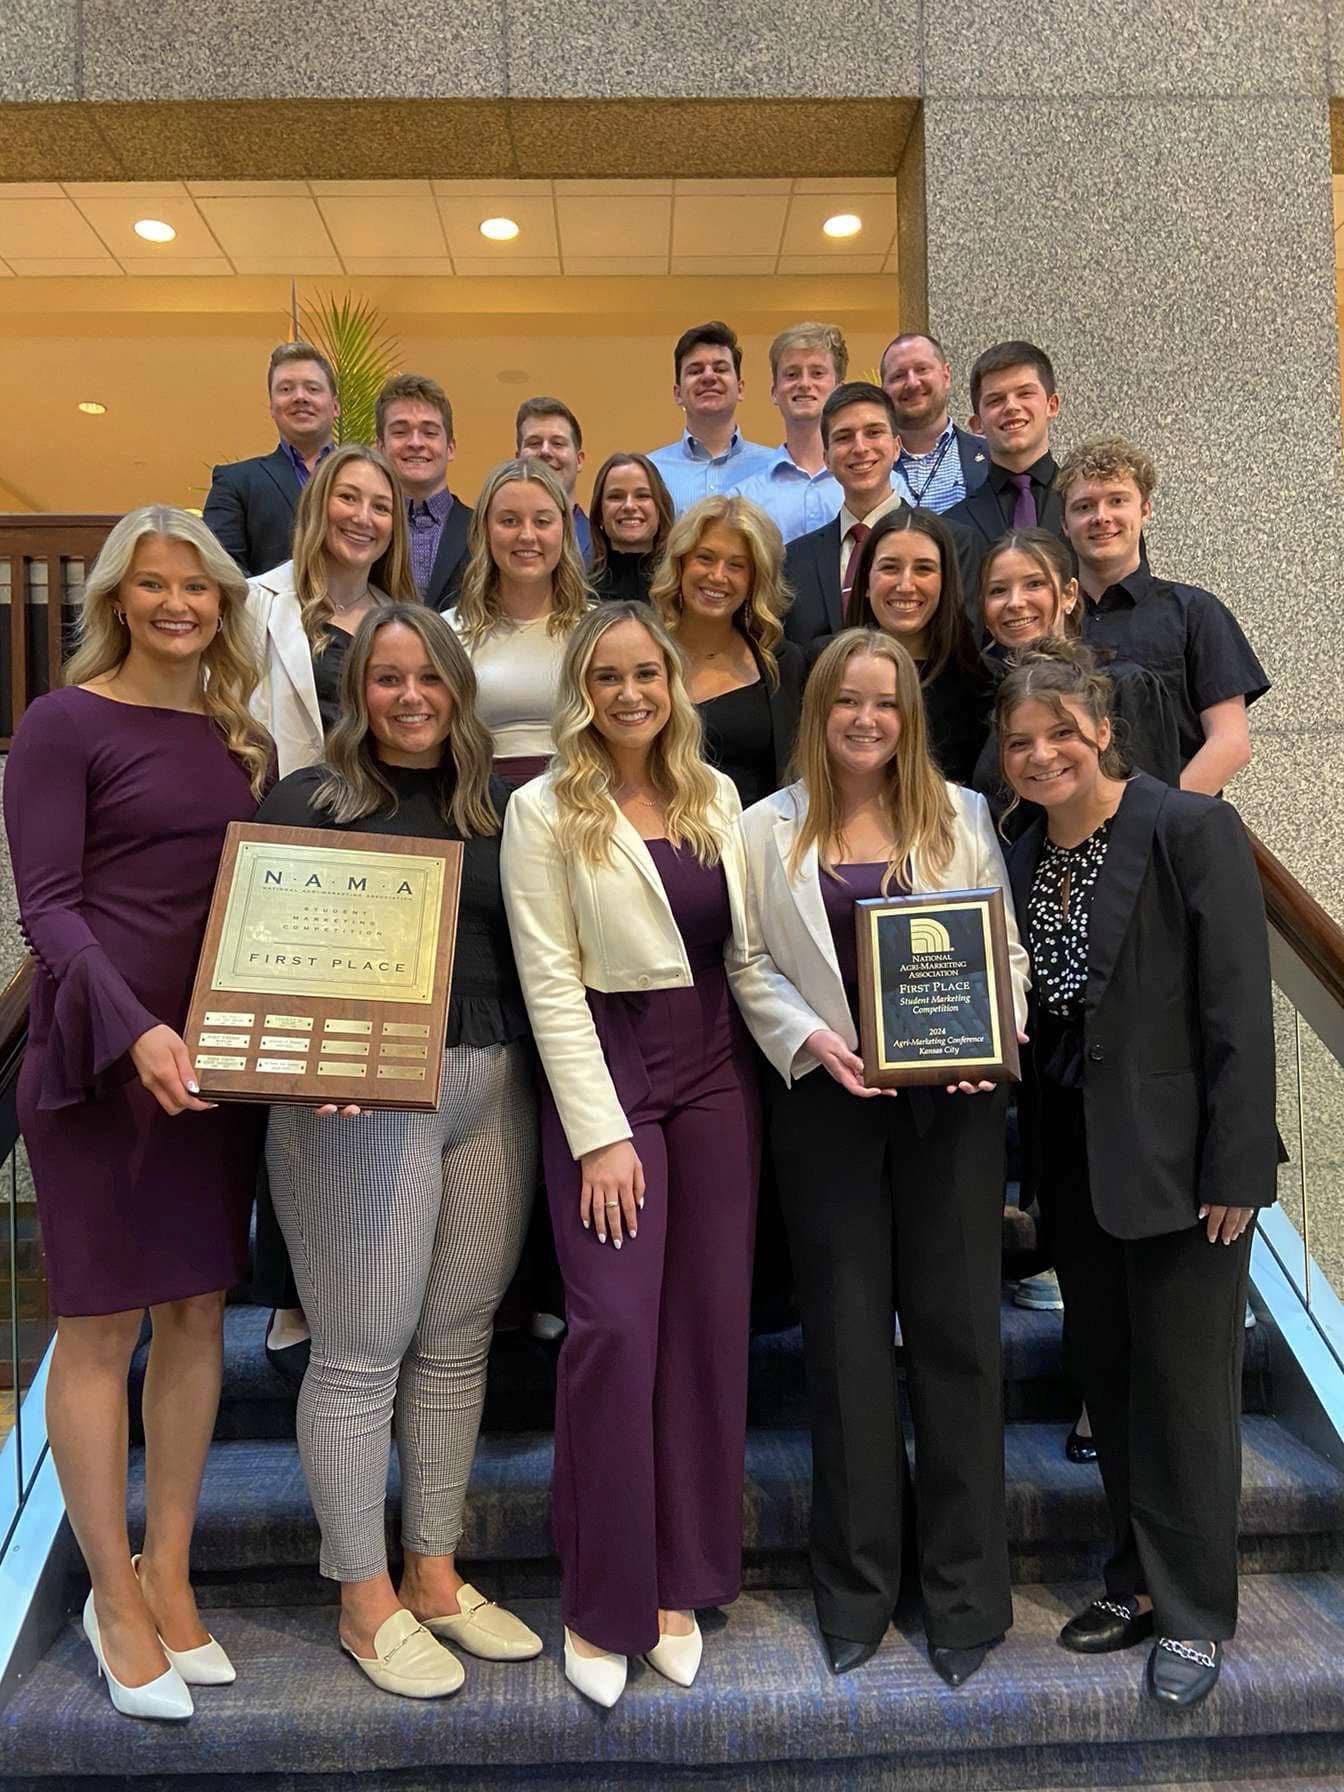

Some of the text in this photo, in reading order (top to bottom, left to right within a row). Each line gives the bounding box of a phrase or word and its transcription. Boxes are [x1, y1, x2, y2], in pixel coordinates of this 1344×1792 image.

[304, 906, 367, 915] STUDENT
[292, 915, 375, 925] MARKETING
[282, 924, 383, 936] COMPETITION
[249, 953, 406, 973] FIRST PLACE
[912, 954, 952, 963] NATIONAL
[900, 961, 967, 972] AGRI-MARKETING
[908, 970, 959, 979] ASSOCIATION
[899, 981, 970, 994] FIRST PLACE
[899, 993, 971, 1006] Student Marketing
[912, 1005, 959, 1015] Competition
[929, 1028, 946, 1036] 2024
[893, 1035, 985, 1049] Agri-Marketing Conference
[919, 1045, 960, 1056] Kansas City
